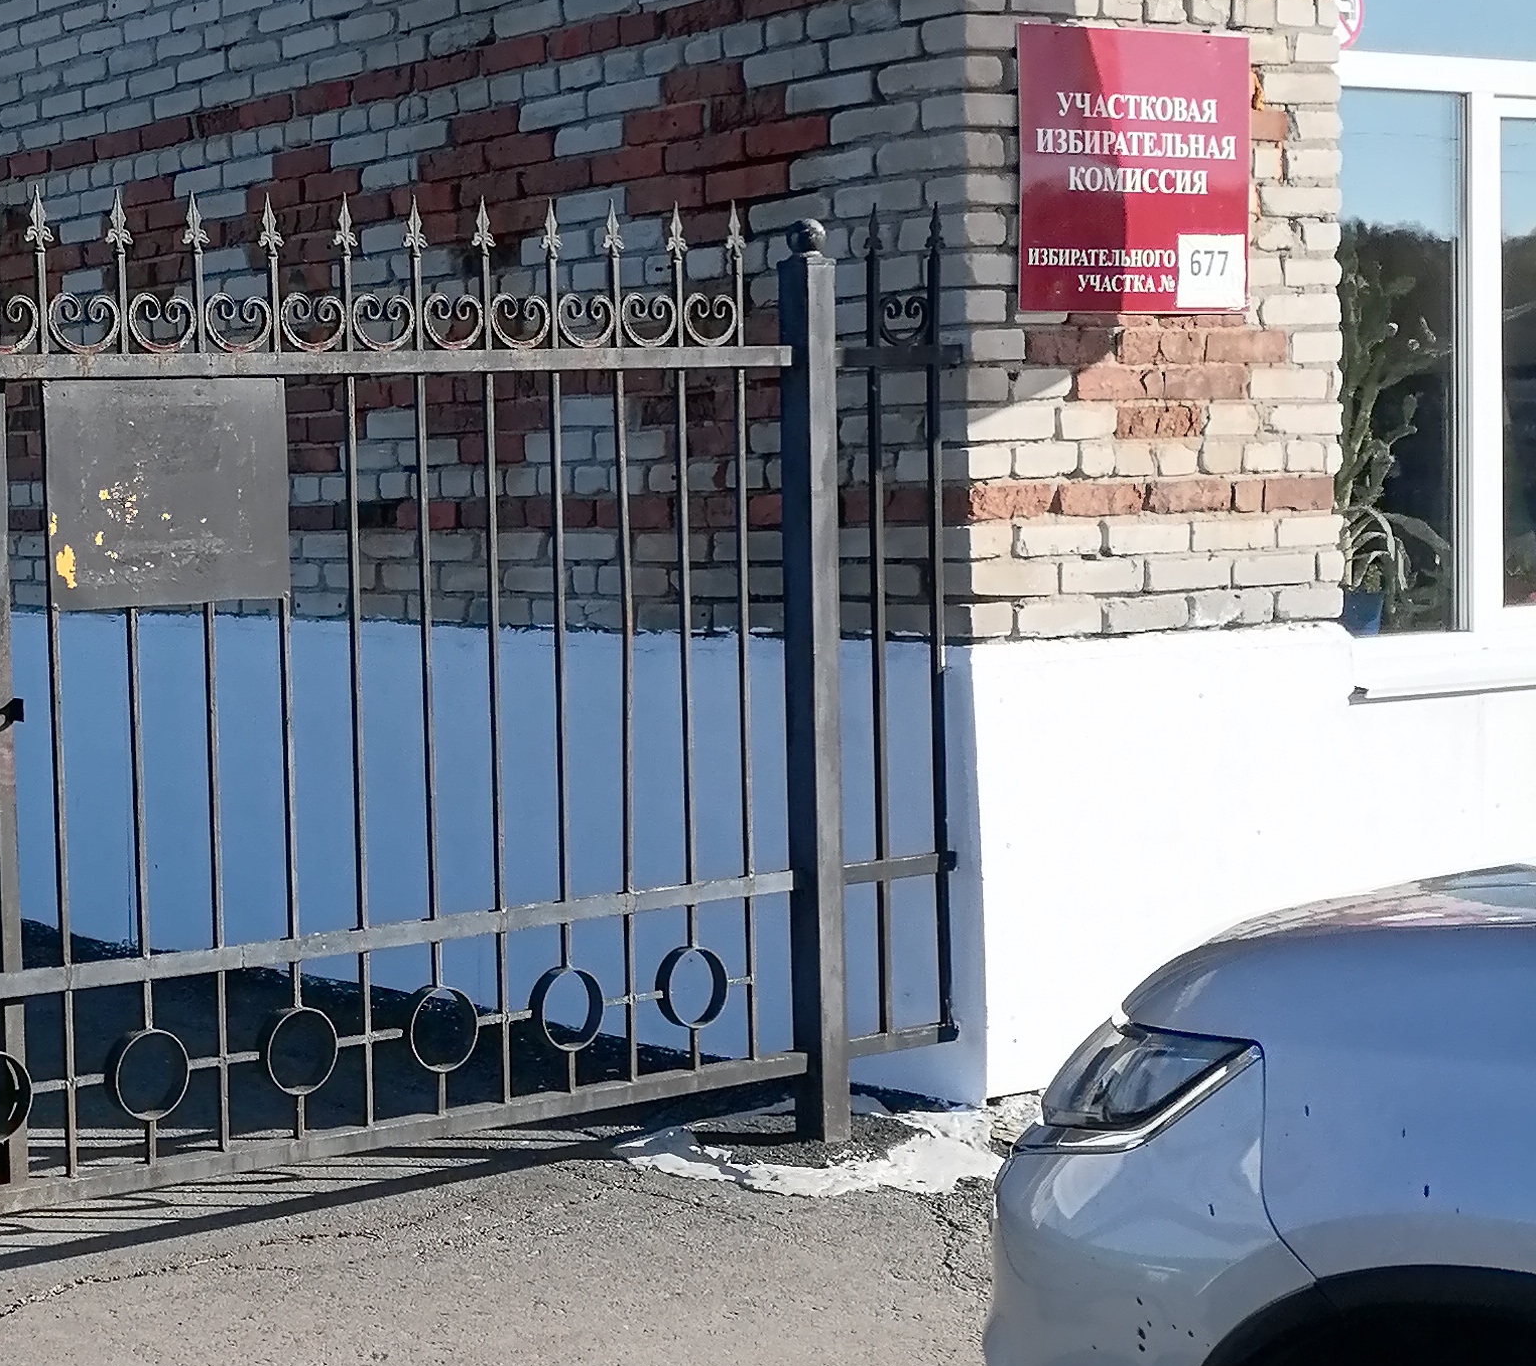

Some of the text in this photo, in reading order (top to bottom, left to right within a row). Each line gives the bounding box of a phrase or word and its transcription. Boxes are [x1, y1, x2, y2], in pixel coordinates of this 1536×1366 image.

[1056, 91, 1218, 123] УЧАСТКОВАЯ
[1035, 128, 1237, 160] ИЗБИРАТЕЛЬНАЯ
[1067, 166, 1209, 195] КОМИССИЯ
[1027, 248, 1176, 268] ИЗБИРАТЕЛЬНОГО
[1190, 249, 1229, 276] 677
[1077, 274, 1175, 293] УЧАСТКА №
